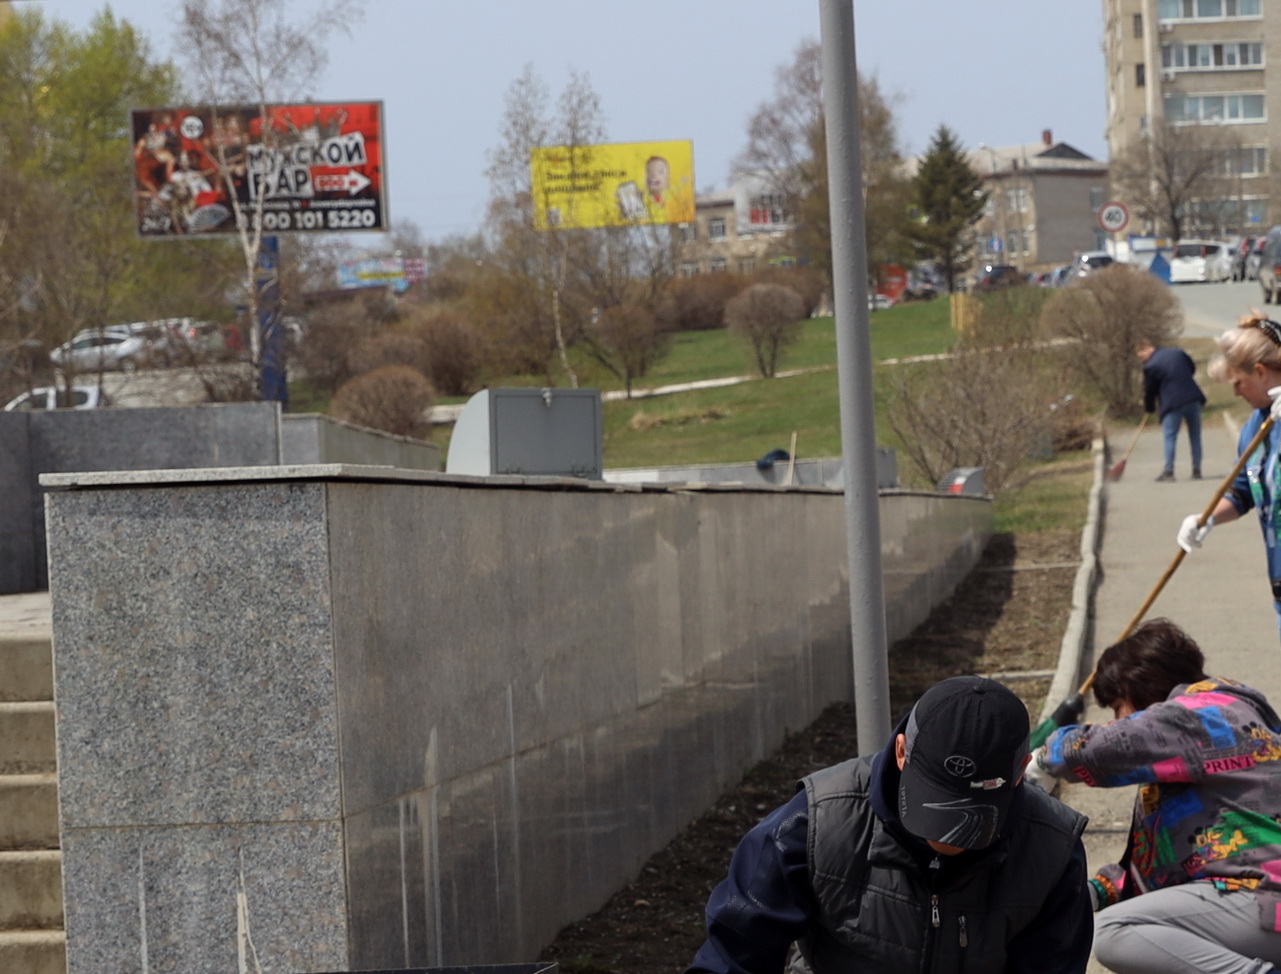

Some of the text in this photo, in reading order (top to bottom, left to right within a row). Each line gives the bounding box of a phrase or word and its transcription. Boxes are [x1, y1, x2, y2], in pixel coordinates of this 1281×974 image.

[253, 168, 309, 196] БАР
[295, 211, 325, 229] 101
[328, 209, 376, 228] 5220
[1104, 210, 1123, 224] 40
[1204, 756, 1252, 774] PRINT
[899, 784, 908, 818] TOYOTA
